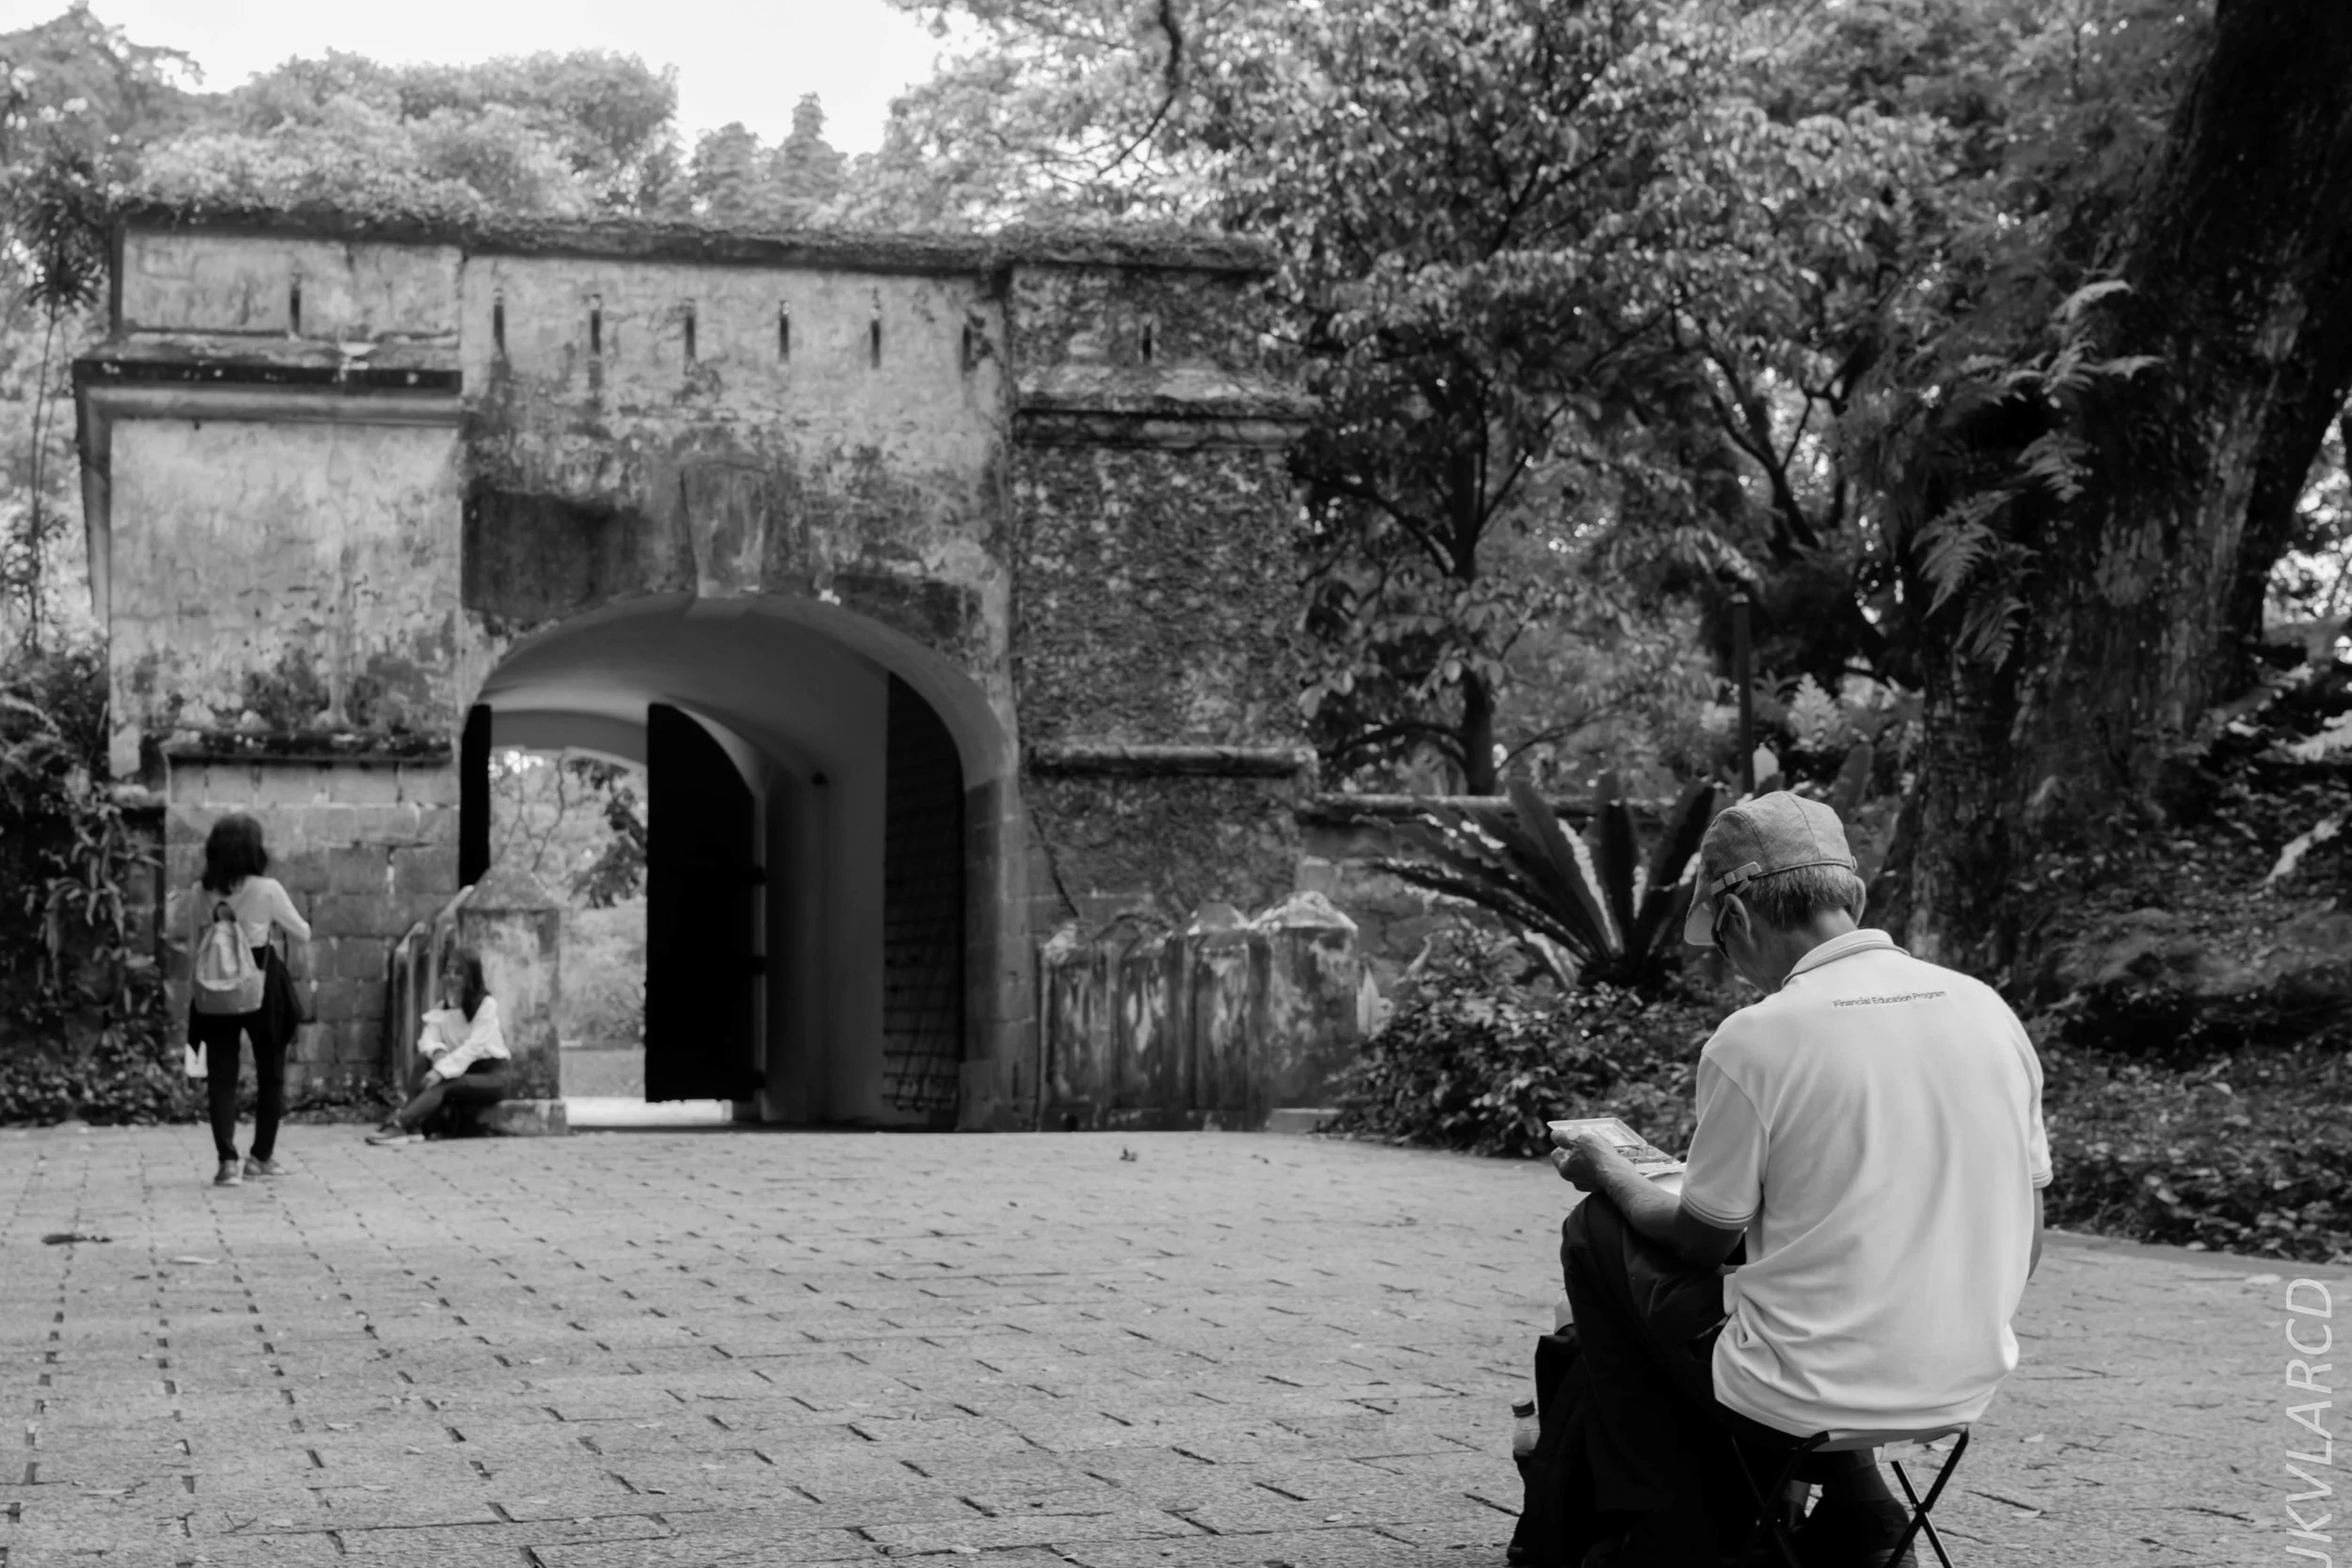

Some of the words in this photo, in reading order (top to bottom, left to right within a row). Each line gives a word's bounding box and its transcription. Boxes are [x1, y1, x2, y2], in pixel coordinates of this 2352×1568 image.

[1834, 997, 1870, 1008] Financial
[1872, 993, 1912, 1004] Education
[1913, 990, 1946, 1000] Program
